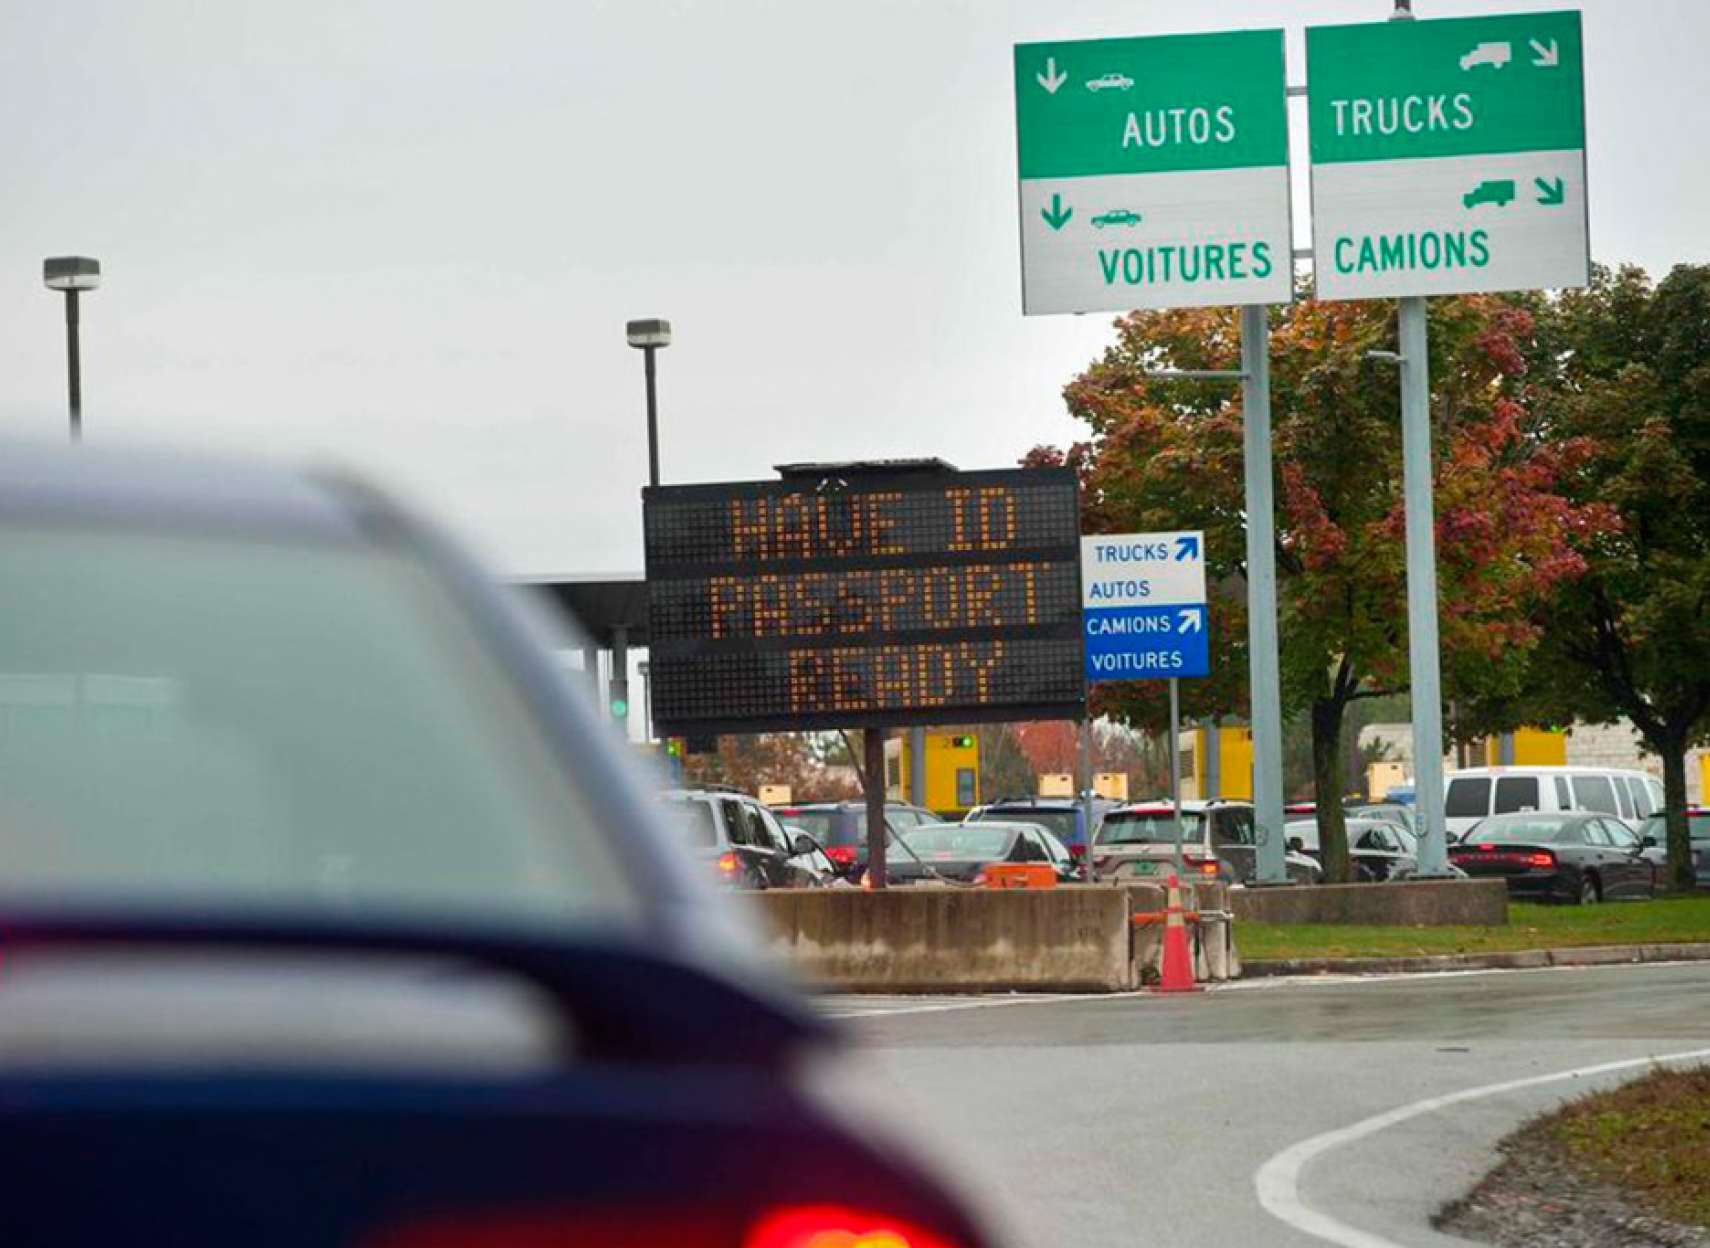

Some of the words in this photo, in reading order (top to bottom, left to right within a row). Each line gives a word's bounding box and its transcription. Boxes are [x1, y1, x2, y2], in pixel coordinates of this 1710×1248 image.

[1122, 106, 1235, 149] AUTOS
[1332, 93, 1474, 137] TRUCKS
[1099, 242, 1272, 285] VOITURES
[1335, 230, 1490, 275] CAMIONS
[731, 492, 904, 560] HAVE
[946, 487, 1017, 551] ID
[1095, 543, 1169, 562] TRUCKS
[710, 562, 1050, 640] PASSPORT
[1089, 580, 1151, 599] AUTOS
[1087, 615, 1171, 635] CAMIONS
[789, 640, 1003, 712] READY
[1091, 651, 1184, 671] VOITURES
